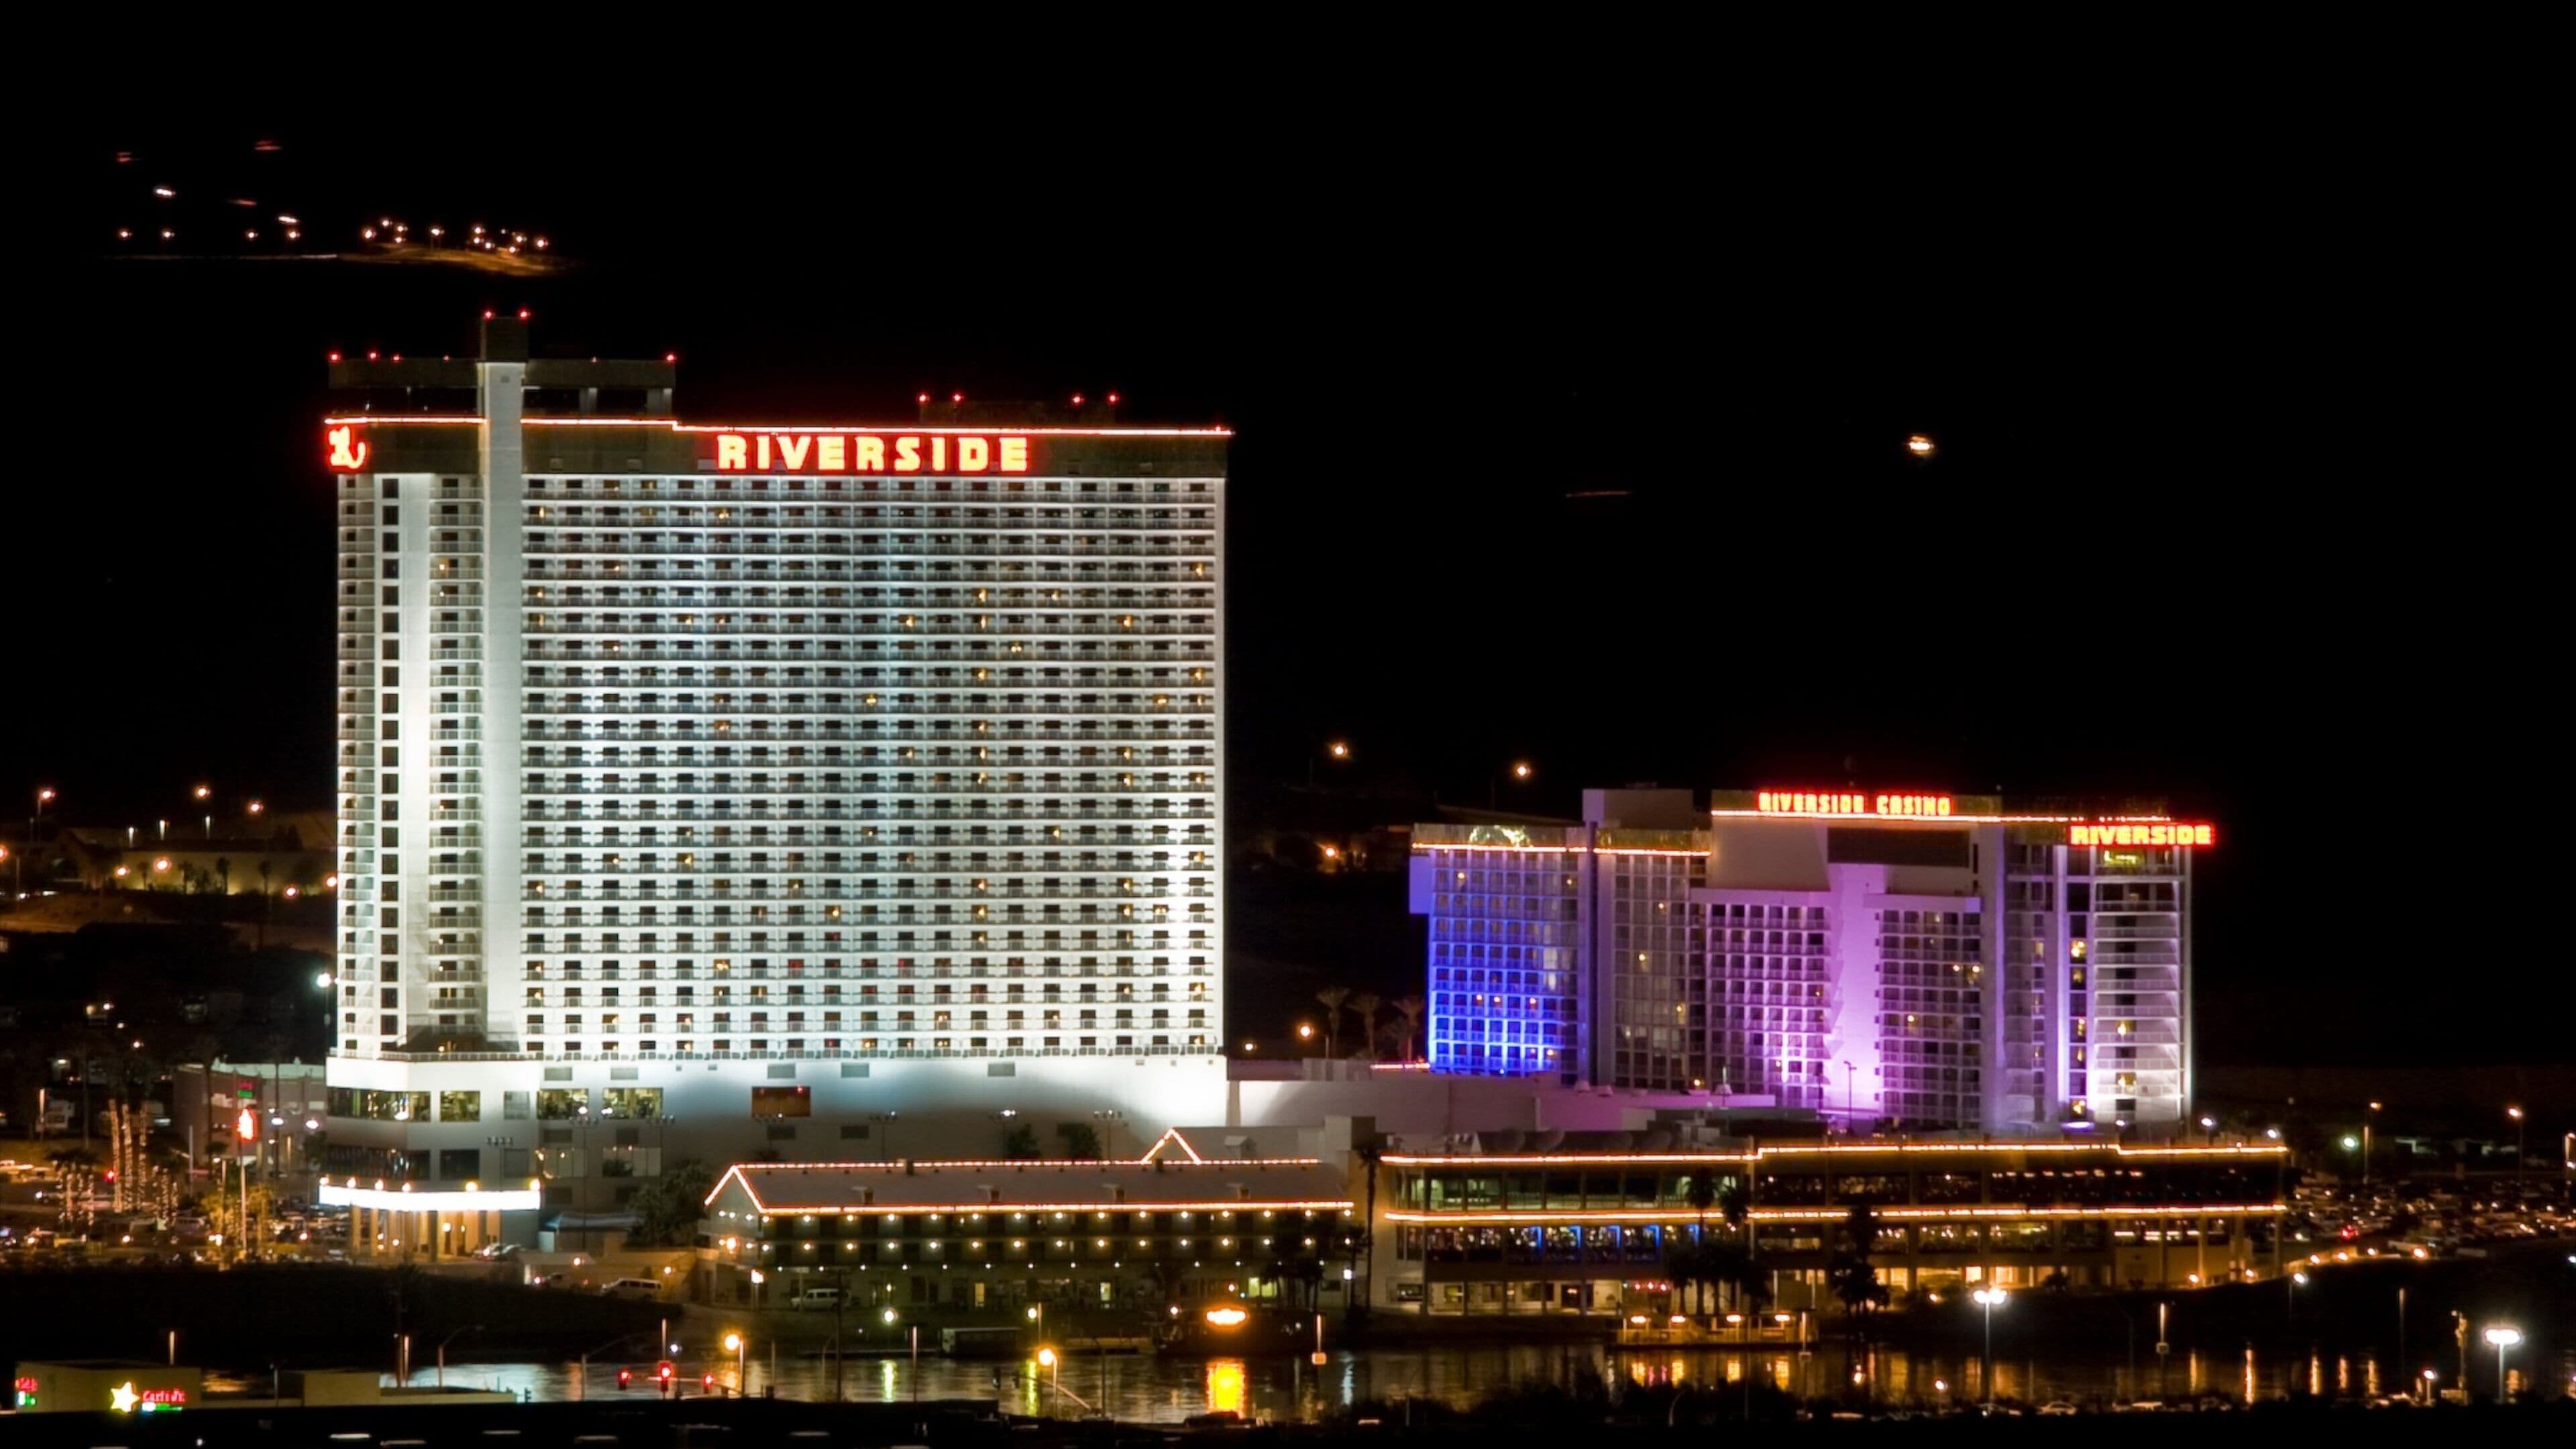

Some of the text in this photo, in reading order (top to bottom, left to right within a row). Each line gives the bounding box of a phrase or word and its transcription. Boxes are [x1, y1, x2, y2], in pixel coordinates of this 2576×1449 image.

[716, 433, 1028, 472] RIVERSIDE
[1758, 792, 1951, 816] RIVERSIDE CASINO
[2070, 825, 2212, 845] RIVERSIDE
